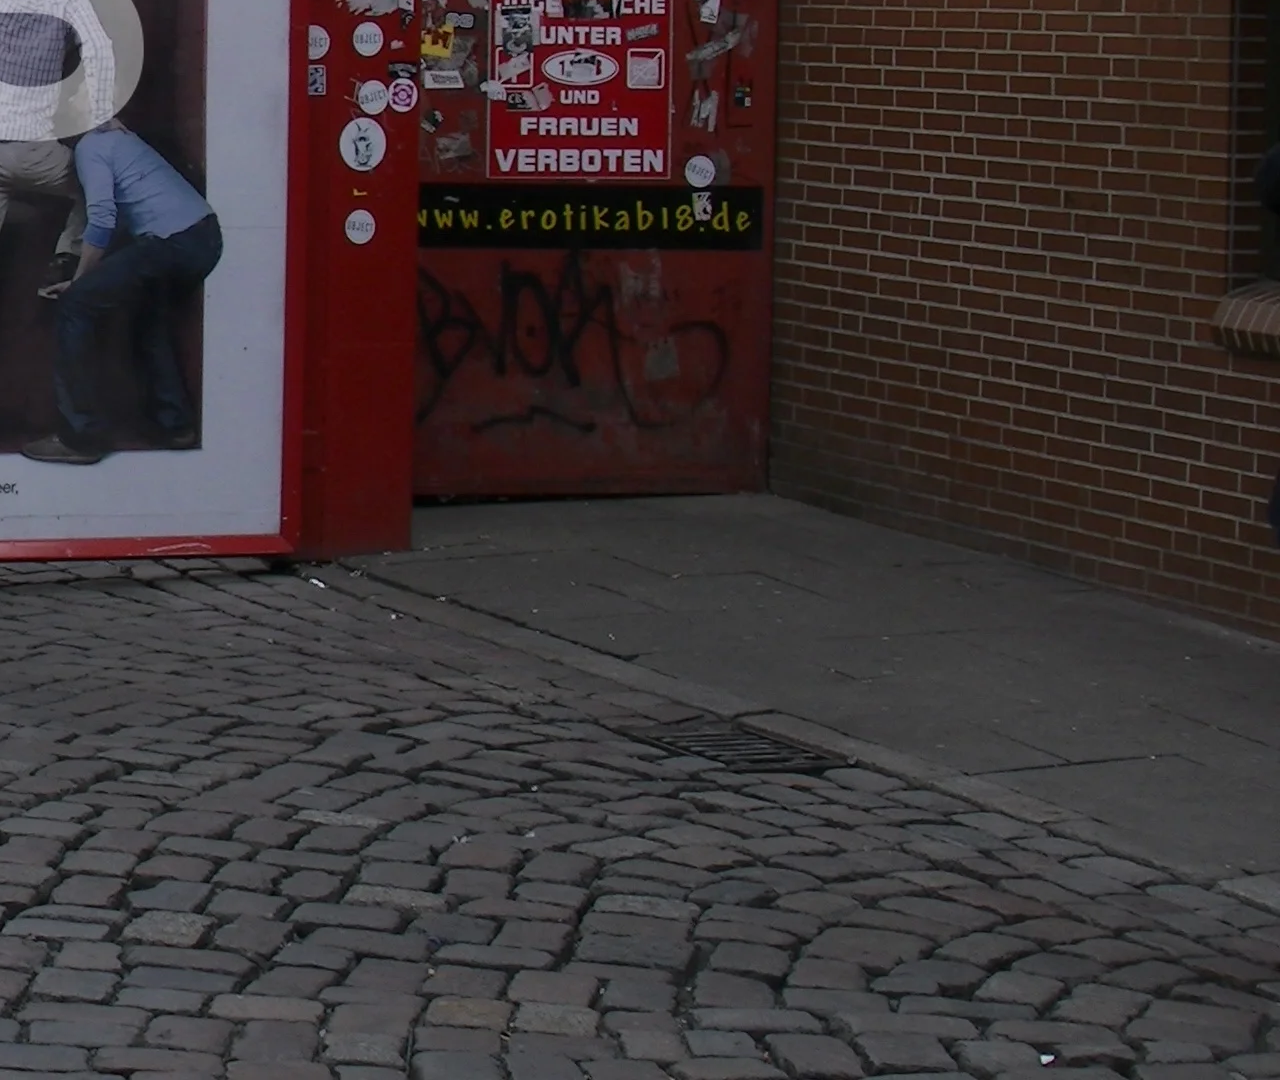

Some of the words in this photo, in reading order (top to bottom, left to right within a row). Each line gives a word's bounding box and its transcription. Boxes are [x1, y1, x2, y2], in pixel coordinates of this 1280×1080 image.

[354, 33, 382, 43] OBJECT
[540, 26, 622, 46] UNTER
[360, 89, 387, 103] OBJECT
[559, 89, 600, 105] UND
[520, 117, 639, 137] FRAUEN
[495, 148, 664, 173] VERBOTEN
[346, 219, 373, 231] OBJECT
